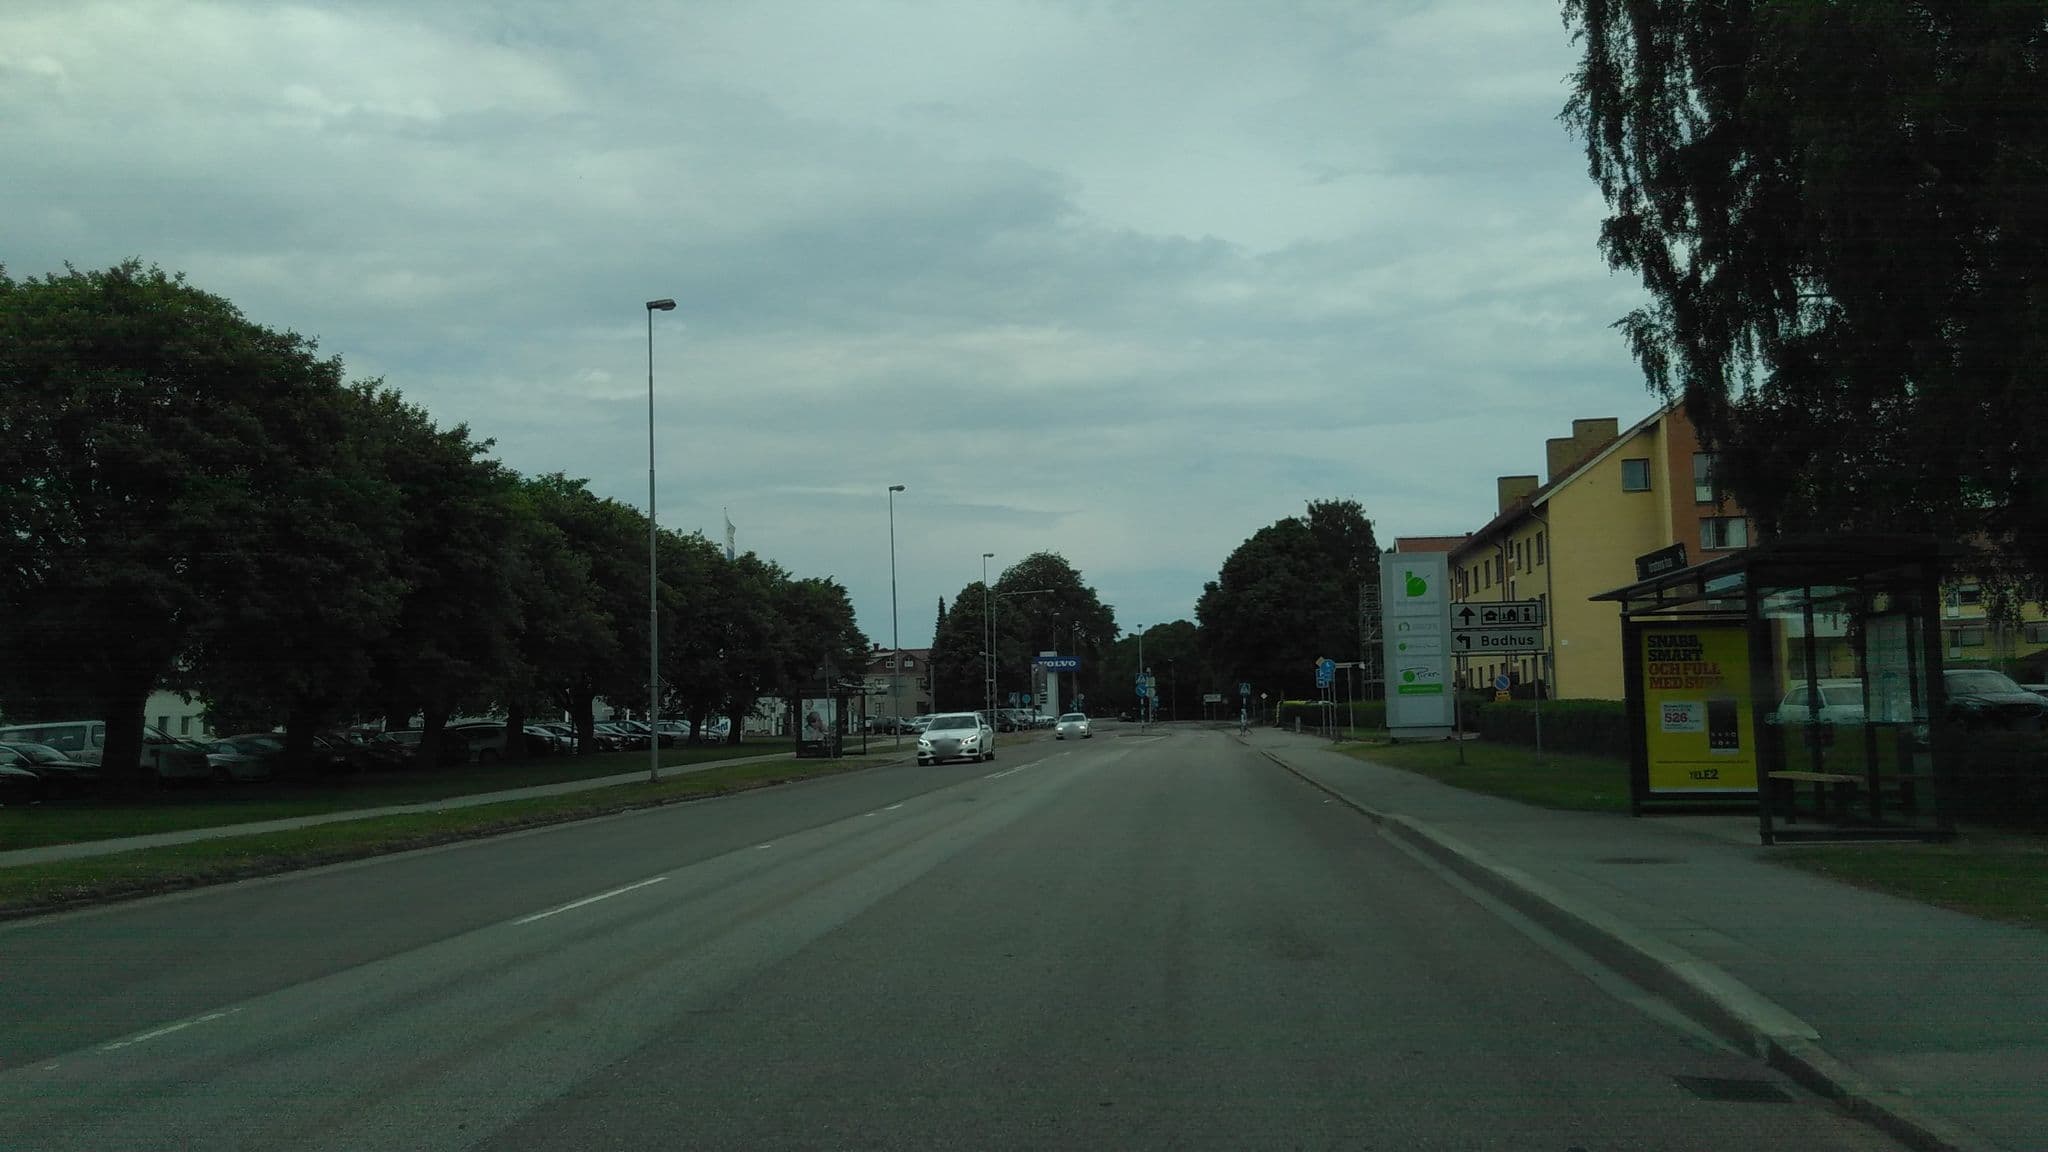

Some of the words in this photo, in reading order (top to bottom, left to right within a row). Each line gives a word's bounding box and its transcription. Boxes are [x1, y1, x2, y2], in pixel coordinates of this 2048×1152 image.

[1481, 634, 1535, 647] Badhus
[1648, 649, 1704, 662] SMART
[1649, 663, 1680, 675] OCH
[1683, 663, 1720, 675] FULL
[1649, 676, 1682, 689] MED
[1689, 768, 1720, 780] TELE2
